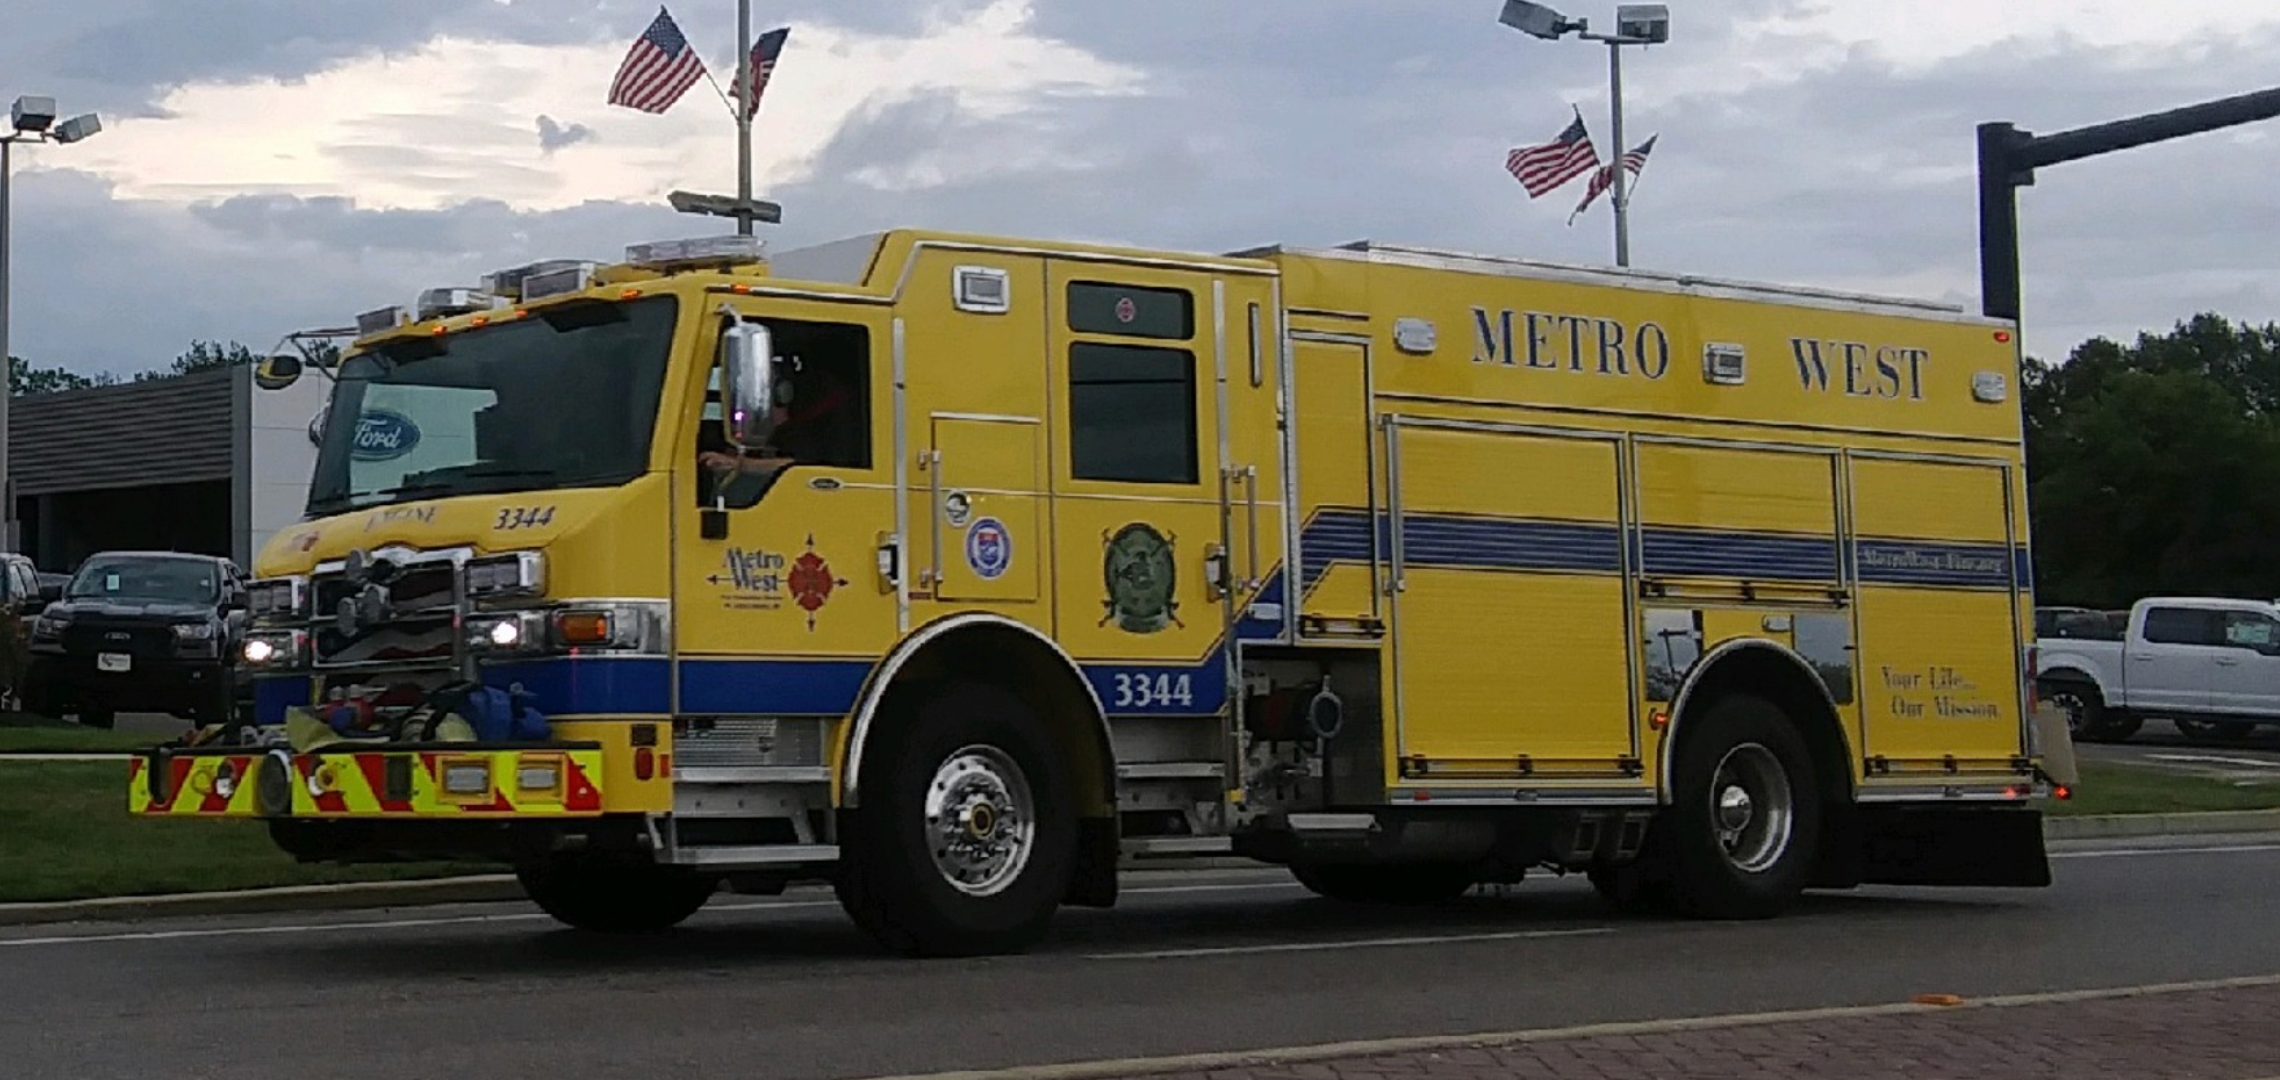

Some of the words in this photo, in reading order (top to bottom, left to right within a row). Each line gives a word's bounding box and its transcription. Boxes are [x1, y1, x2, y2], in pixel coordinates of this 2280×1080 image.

[1471, 306, 1670, 380] METRO
[1790, 337, 1930, 401] WEST
[353, 418, 402, 448] Ford
[493, 506, 557, 530] 3344
[722, 547, 785, 569] Metro
[730, 567, 779, 592] West
[1114, 673, 1193, 707] 3344
[1891, 695, 1924, 718] Our
